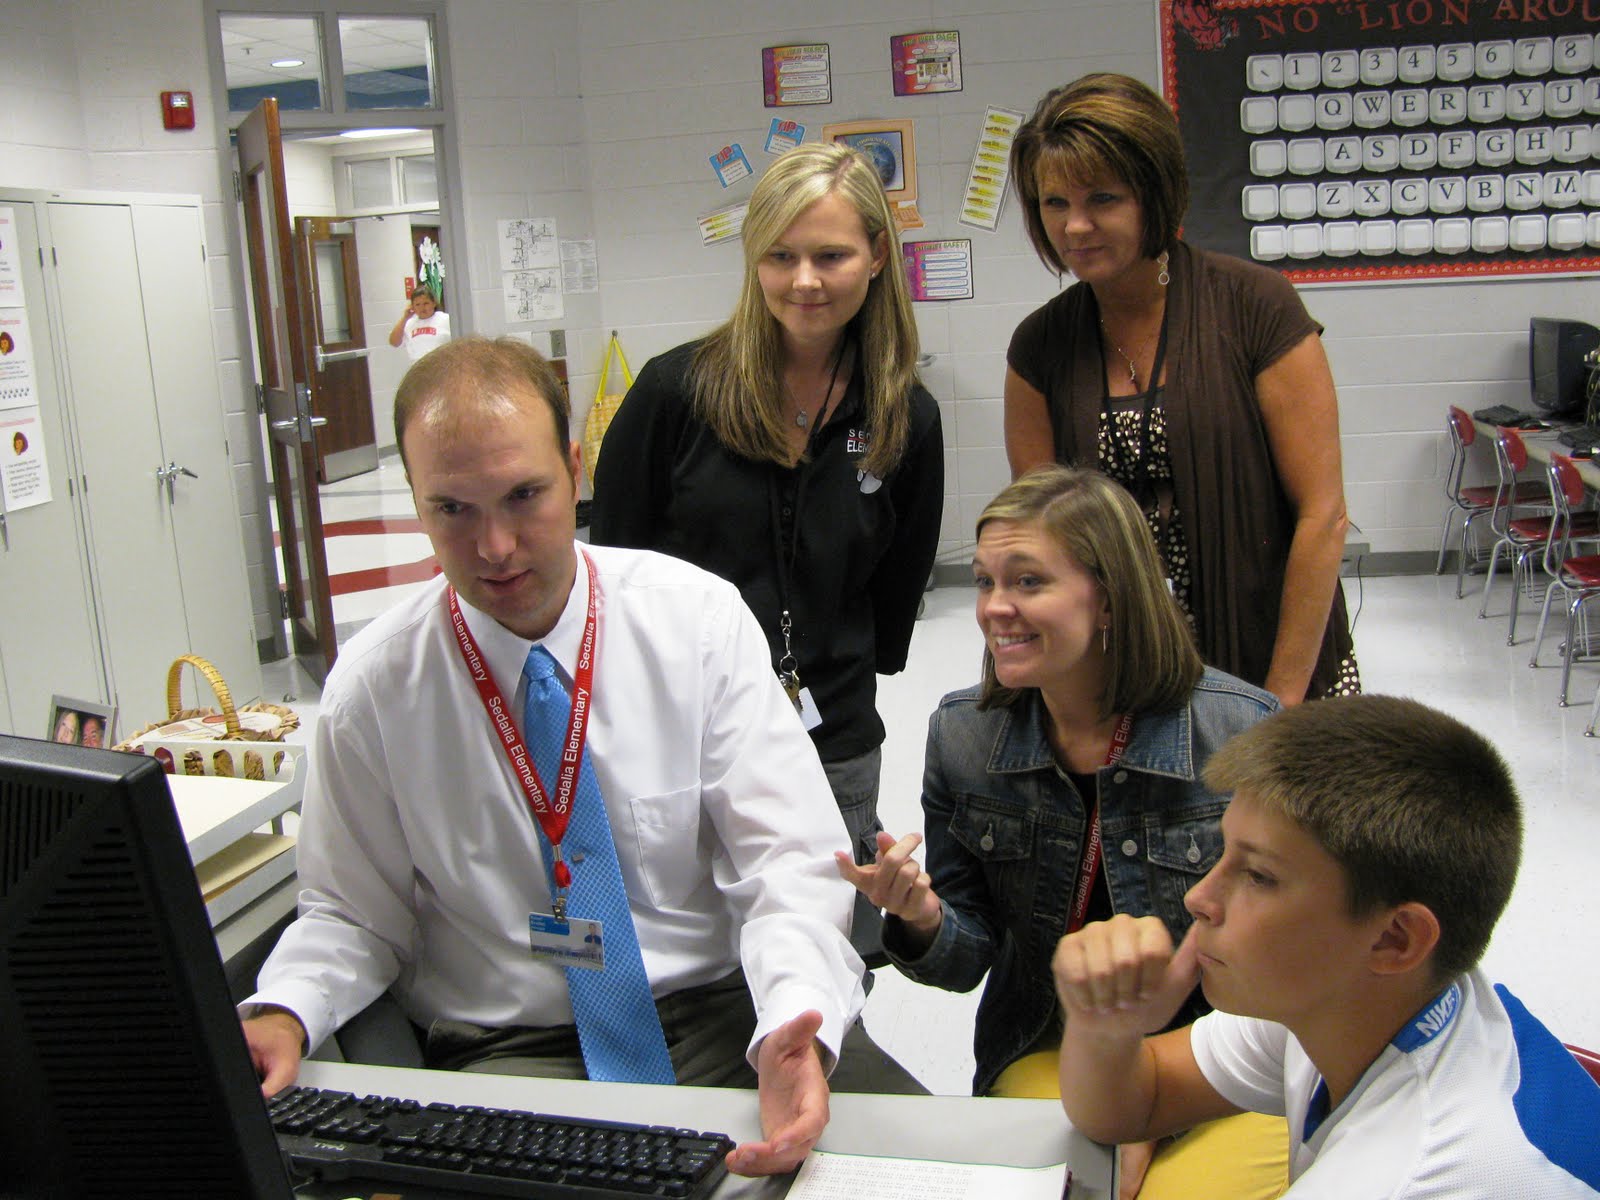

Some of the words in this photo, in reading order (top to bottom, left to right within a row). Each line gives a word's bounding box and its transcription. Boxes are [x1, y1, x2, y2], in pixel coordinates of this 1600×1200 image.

[1256, 6, 1319, 40] NO
[1292, 59, 1300, 75] 1
[1330, 57, 1342, 73] 2
[1369, 54, 1380, 70] 3
[1407, 51, 1420, 68] 4
[1447, 49, 1458, 66] 5
[1486, 46, 1497, 63] 6
[1525, 43, 1536, 60] 7
[1564, 41, 1576, 58] 8
[1324, 98, 1342, 116] Q
[1362, 96, 1385, 113] W
[1401, 94, 1416, 112] E
[1439, 93, 1456, 110] R
[1478, 90, 1495, 108] T
[1516, 88, 1533, 106] Y
[1556, 85, 1573, 103] U
[1334, 143, 1351, 160] A
[1371, 141, 1384, 157] S
[1409, 138, 1428, 156] D
[1448, 137, 1463, 155] F
[1486, 134, 1505, 153] G
[1526, 132, 1545, 150] H
[1564, 131, 1575, 152] J
[1326, 188, 1341, 205] Z
[1363, 186, 1381, 203] X
[1400, 184, 1416, 201] C
[1439, 183, 1456, 200] V
[1477, 181, 1493, 198] B
[1515, 179, 1535, 197] N
[1552, 176, 1577, 194] M
[453, 611, 488, 681] Elementary
[579, 622, 595, 670] Sedalia
[564, 687, 589, 763] Elementary
[489, 696, 516, 744] Sedalia
[510, 743, 549, 814] Elementary
[554, 766, 575, 814] Sedalia
